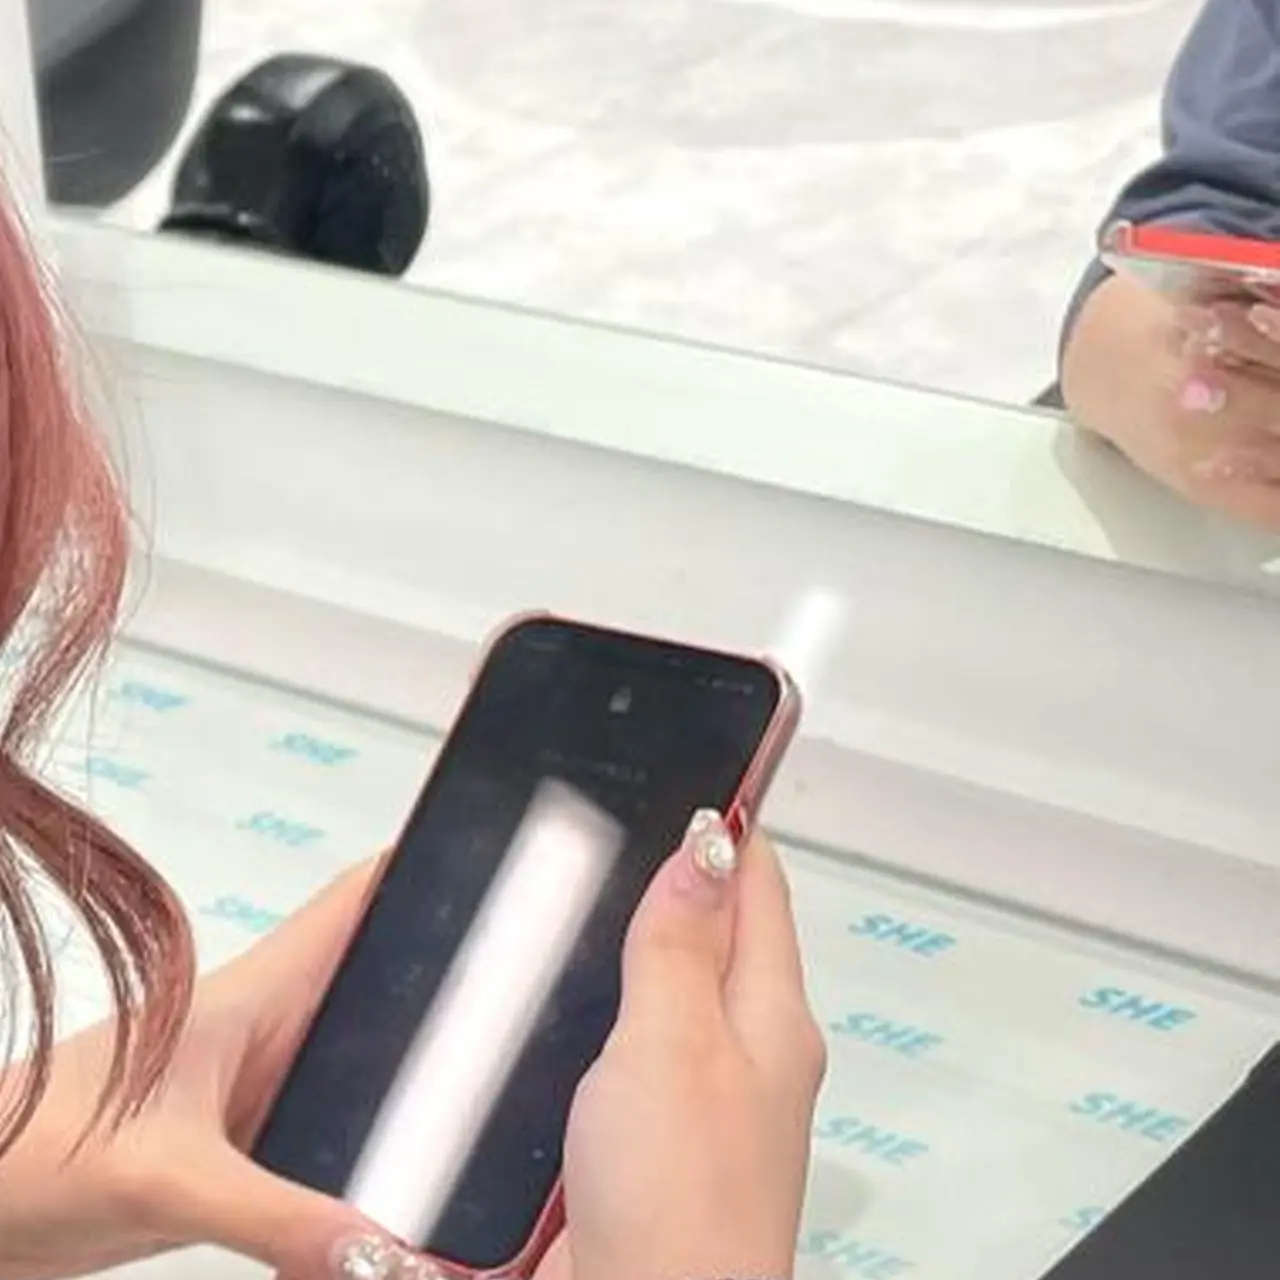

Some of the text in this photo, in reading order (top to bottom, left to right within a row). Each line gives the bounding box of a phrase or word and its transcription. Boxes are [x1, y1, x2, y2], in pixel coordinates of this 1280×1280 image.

[848, 914, 957, 957] SHE
[1078, 986, 1197, 1031] SHE
[829, 1013, 944, 1057] SHE
[1069, 1092, 1193, 1142] SHE
[814, 1116, 930, 1166] SHE
[802, 1230, 917, 1280] SHE
